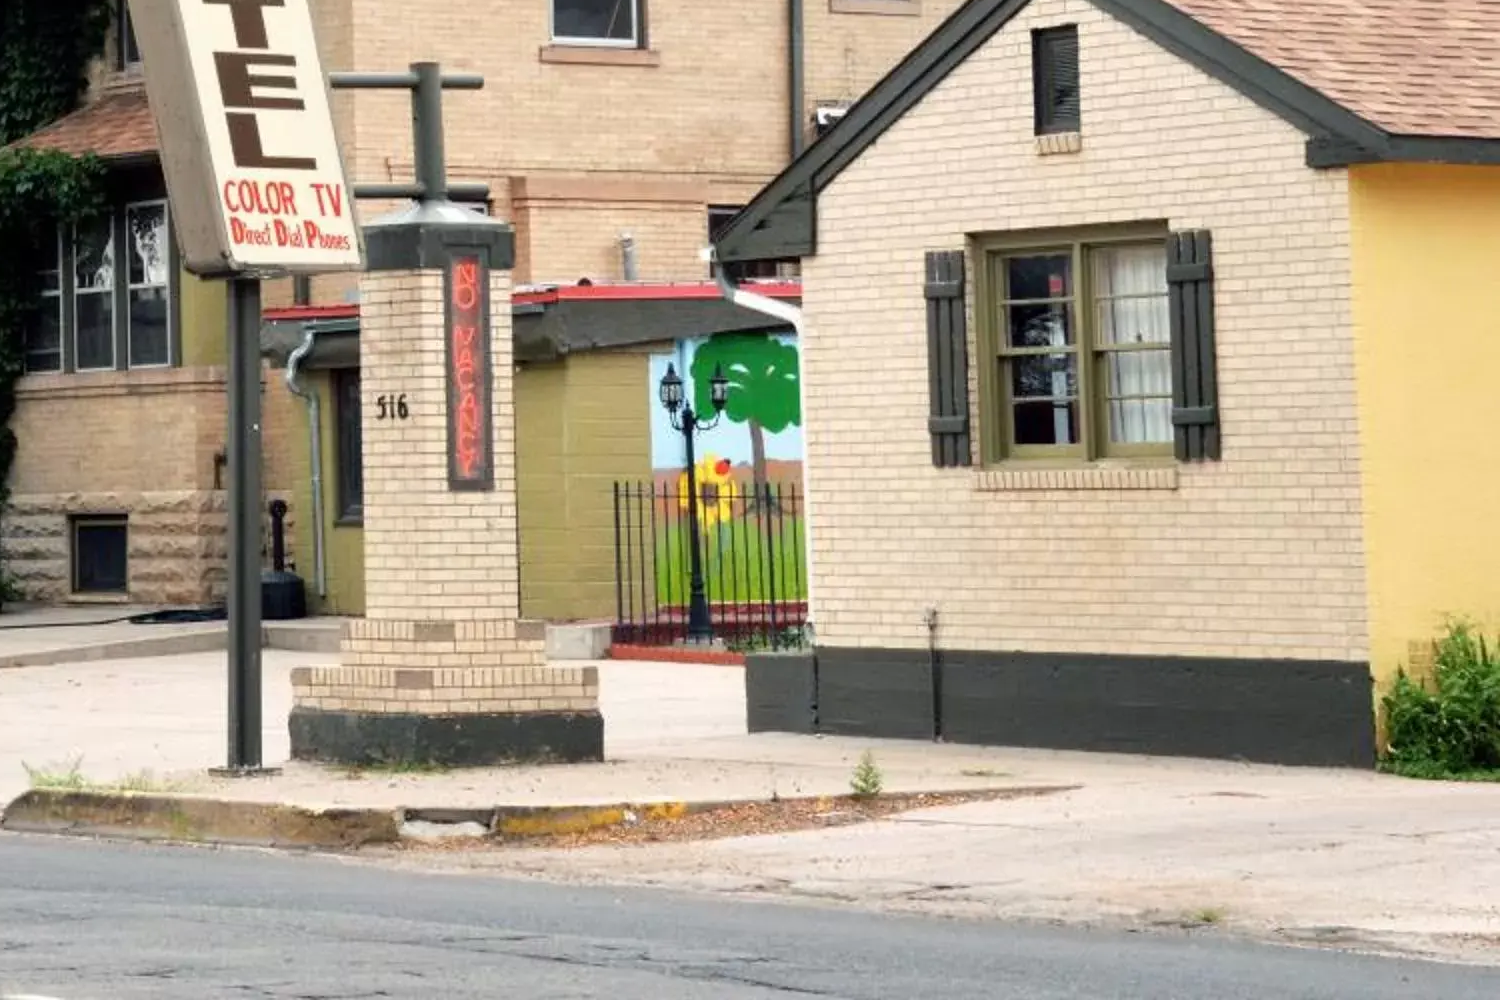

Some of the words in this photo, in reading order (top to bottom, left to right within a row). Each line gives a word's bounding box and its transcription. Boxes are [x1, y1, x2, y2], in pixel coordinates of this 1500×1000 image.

[224, 180, 298, 216] COLOR
[310, 183, 342, 217] TV
[230, 217, 272, 246] Direct
[273, 219, 304, 249] Dial
[303, 220, 350, 251] Phones
[455, 263, 477, 310] NO
[376, 394, 409, 421] 516
[454, 326, 479, 479] VACANCY
